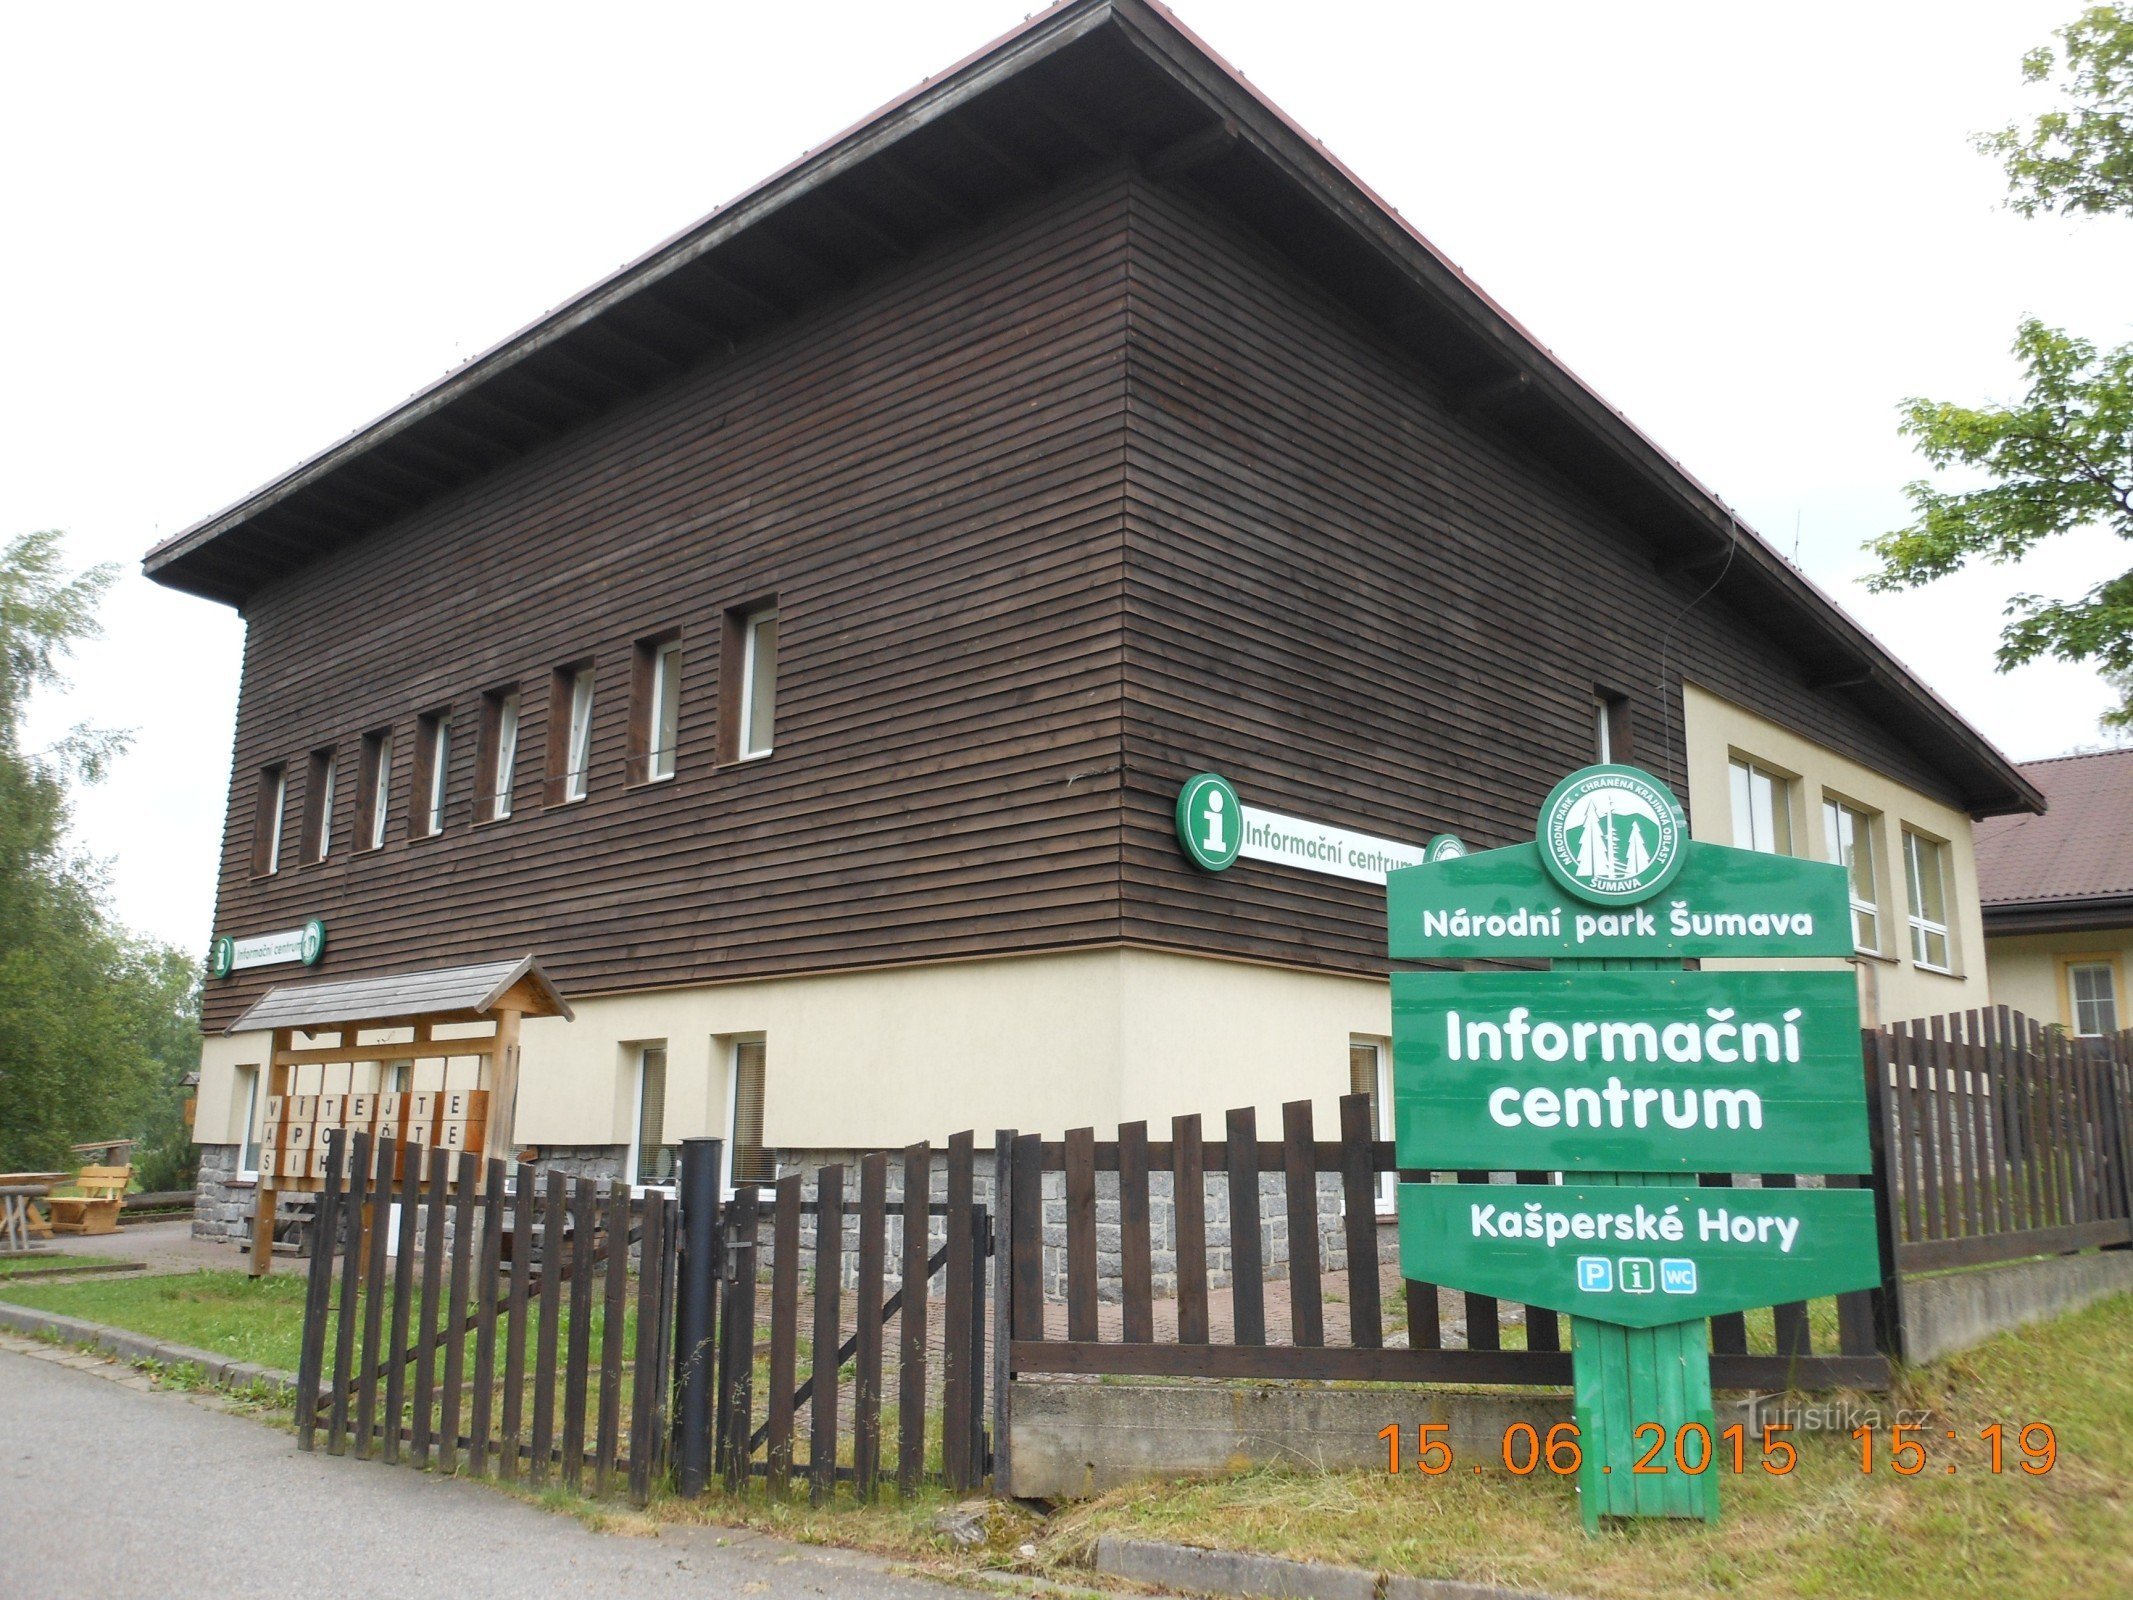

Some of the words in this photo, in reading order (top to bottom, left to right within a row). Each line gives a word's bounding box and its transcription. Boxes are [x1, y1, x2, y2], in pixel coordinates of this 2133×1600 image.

[1246, 821, 1342, 864] Informační
[1553, 820, 1572, 865] NÁRODNÍ
[1656, 827, 1672, 865] OBLAST
[1589, 877, 1642, 892] ŠUMAVA
[1423, 908, 1562, 938] Národní
[1576, 908, 1657, 943] park
[1670, 901, 1813, 937] Šumava
[1446, 1006, 1802, 1064] Informační
[1488, 1076, 1764, 1130] centrum
[1471, 1203, 1684, 1247] Kašperské
[1698, 1208, 1800, 1252] Hory
[1665, 1270, 1692, 1285] WC
